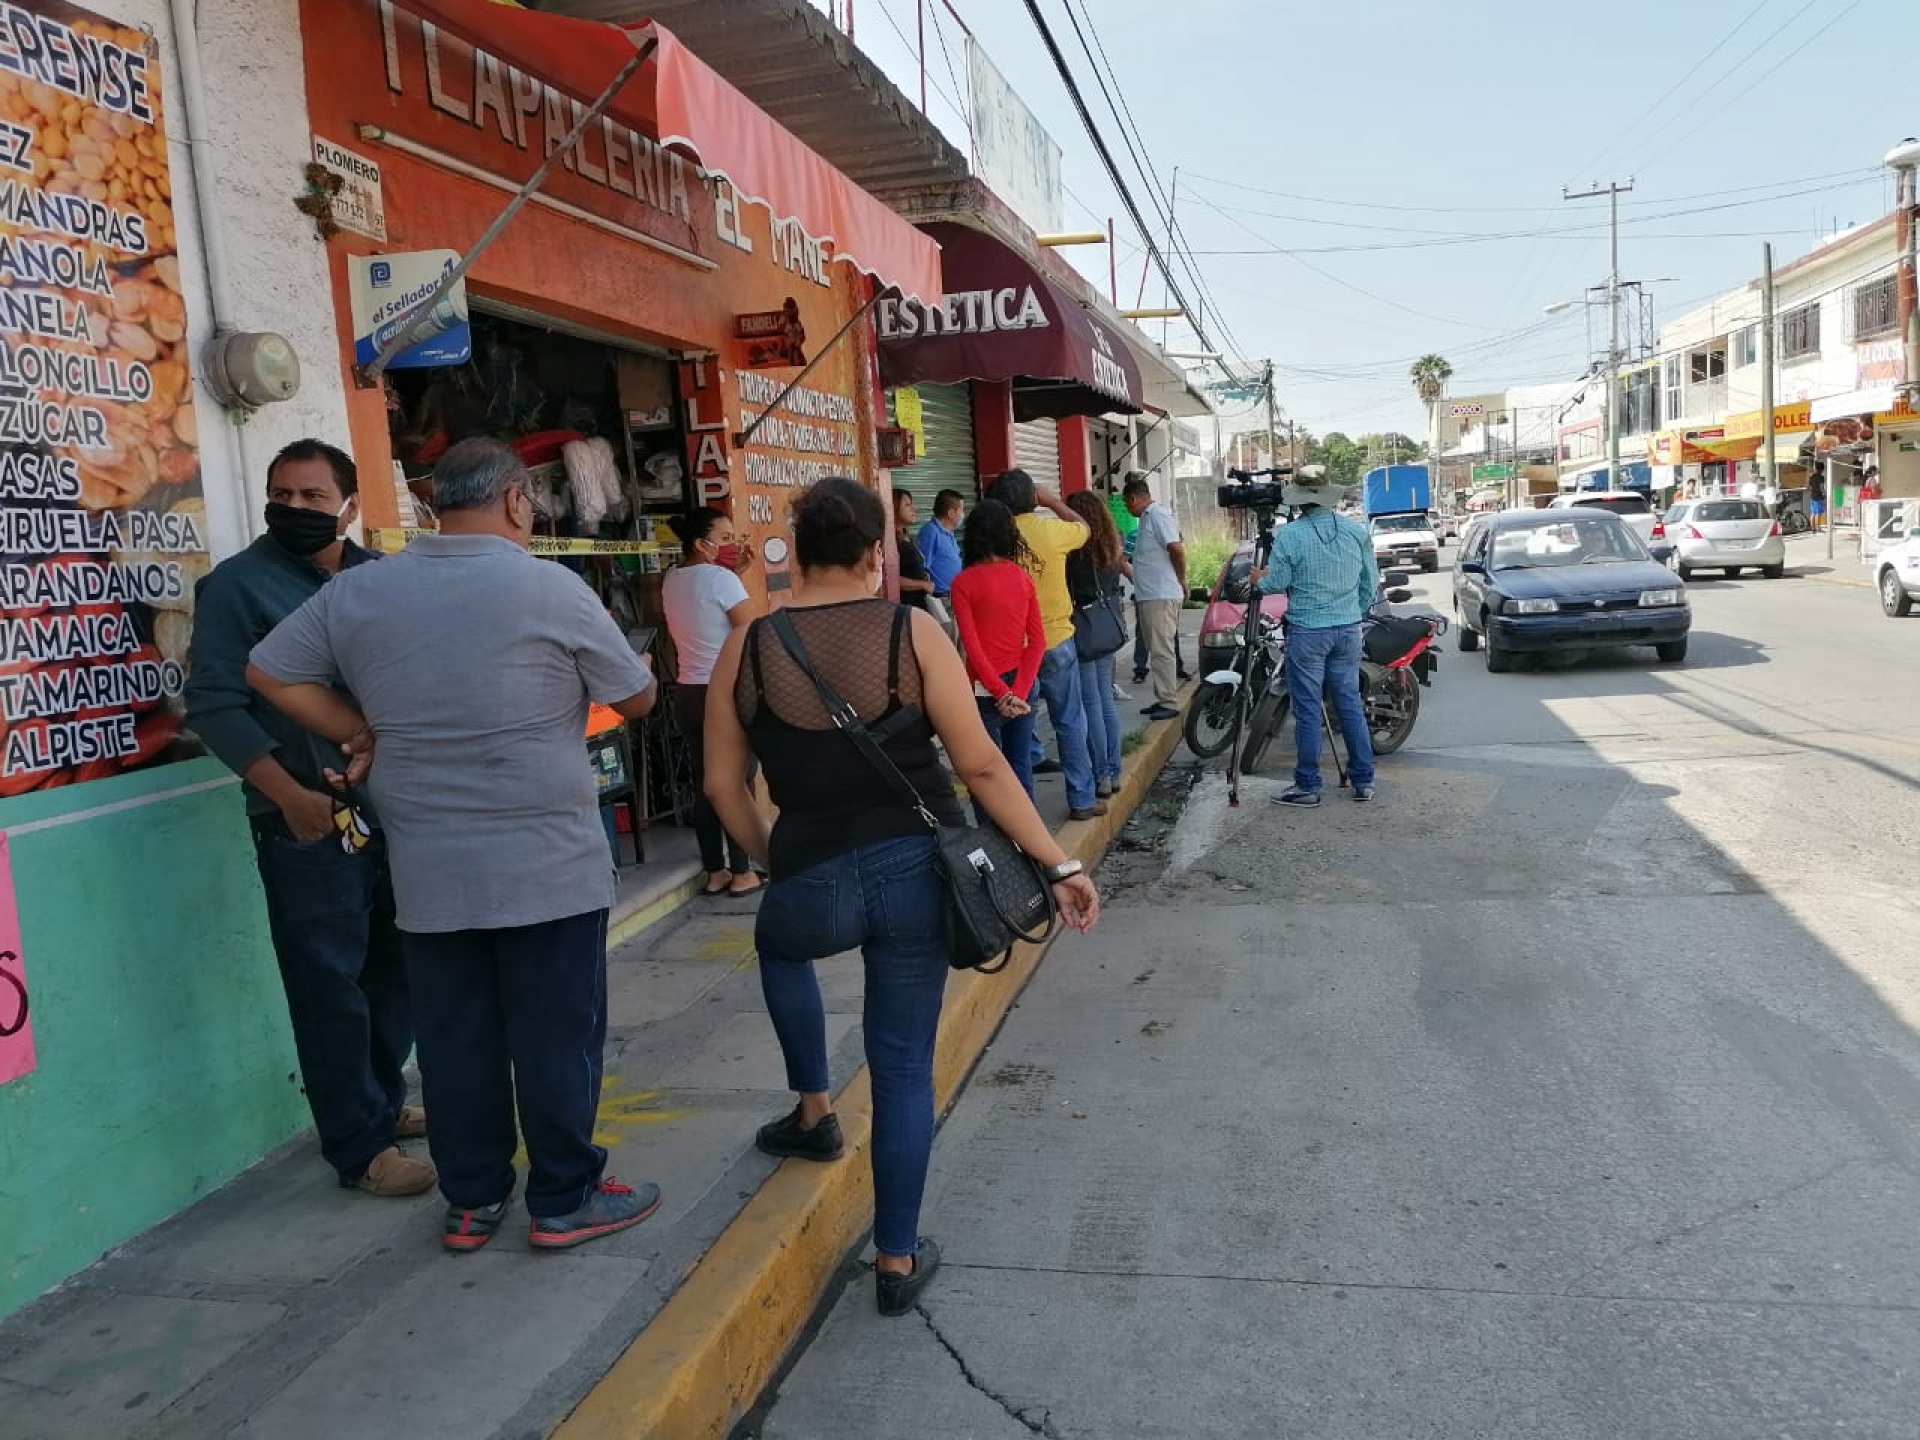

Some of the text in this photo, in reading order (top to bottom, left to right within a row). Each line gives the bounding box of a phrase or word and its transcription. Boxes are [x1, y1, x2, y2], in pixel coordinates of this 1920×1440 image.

[316, 143, 379, 183] PLOMERO
[373, 306, 384, 323] el
[386, 280, 440, 316] Sellador
[0, 511, 201, 551] IRUELA PASA
[0, 664, 183, 717] TAMARINDO
[6, 717, 137, 773] ALPISTE
